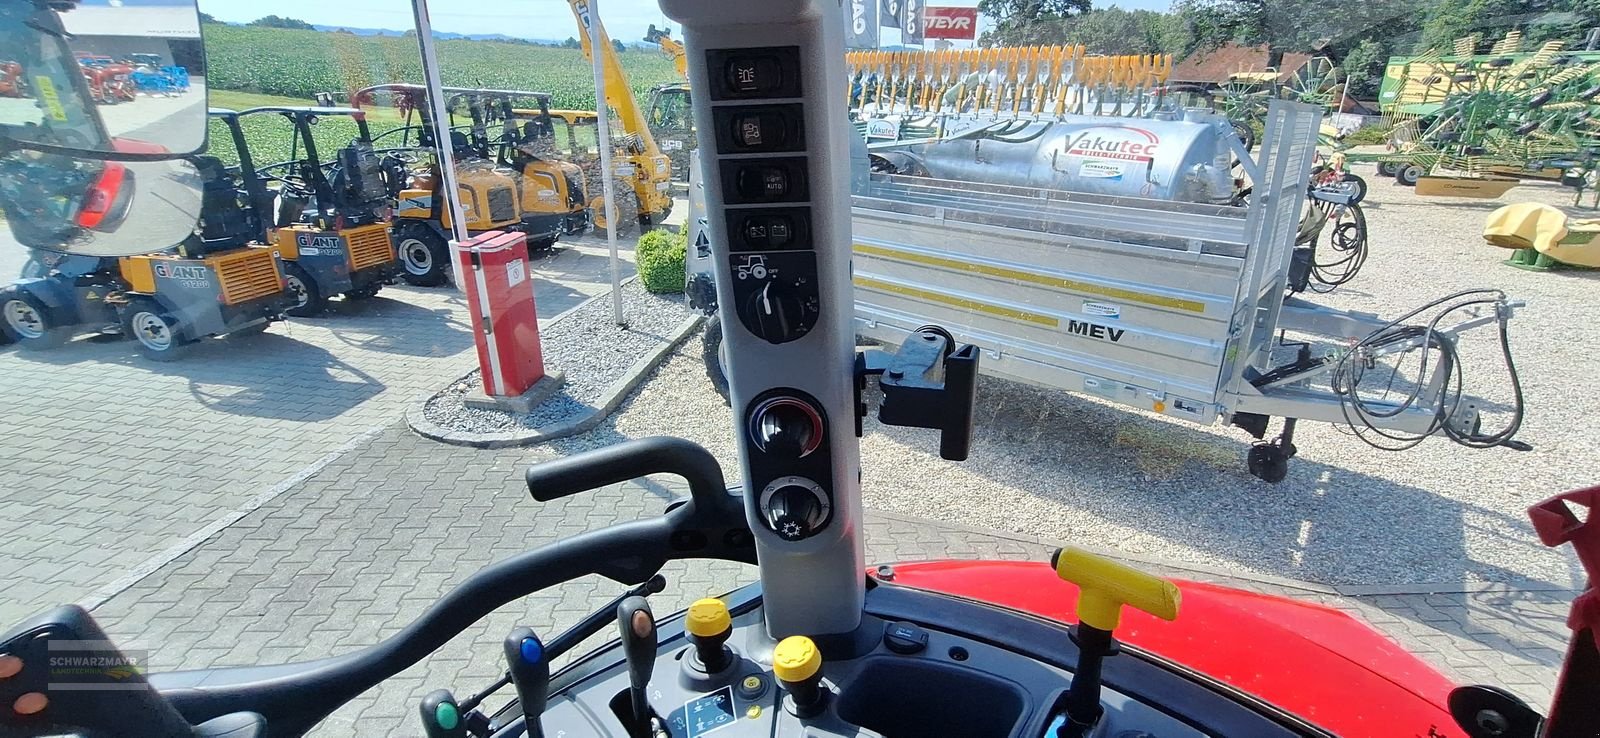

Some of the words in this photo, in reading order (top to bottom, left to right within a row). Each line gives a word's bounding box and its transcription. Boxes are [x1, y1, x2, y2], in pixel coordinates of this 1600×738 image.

[869, 124, 896, 135] Vakutec
[1065, 131, 1158, 156] Vakutec
[181, 279, 210, 289] G1200
[1067, 319, 1125, 343] MEV
